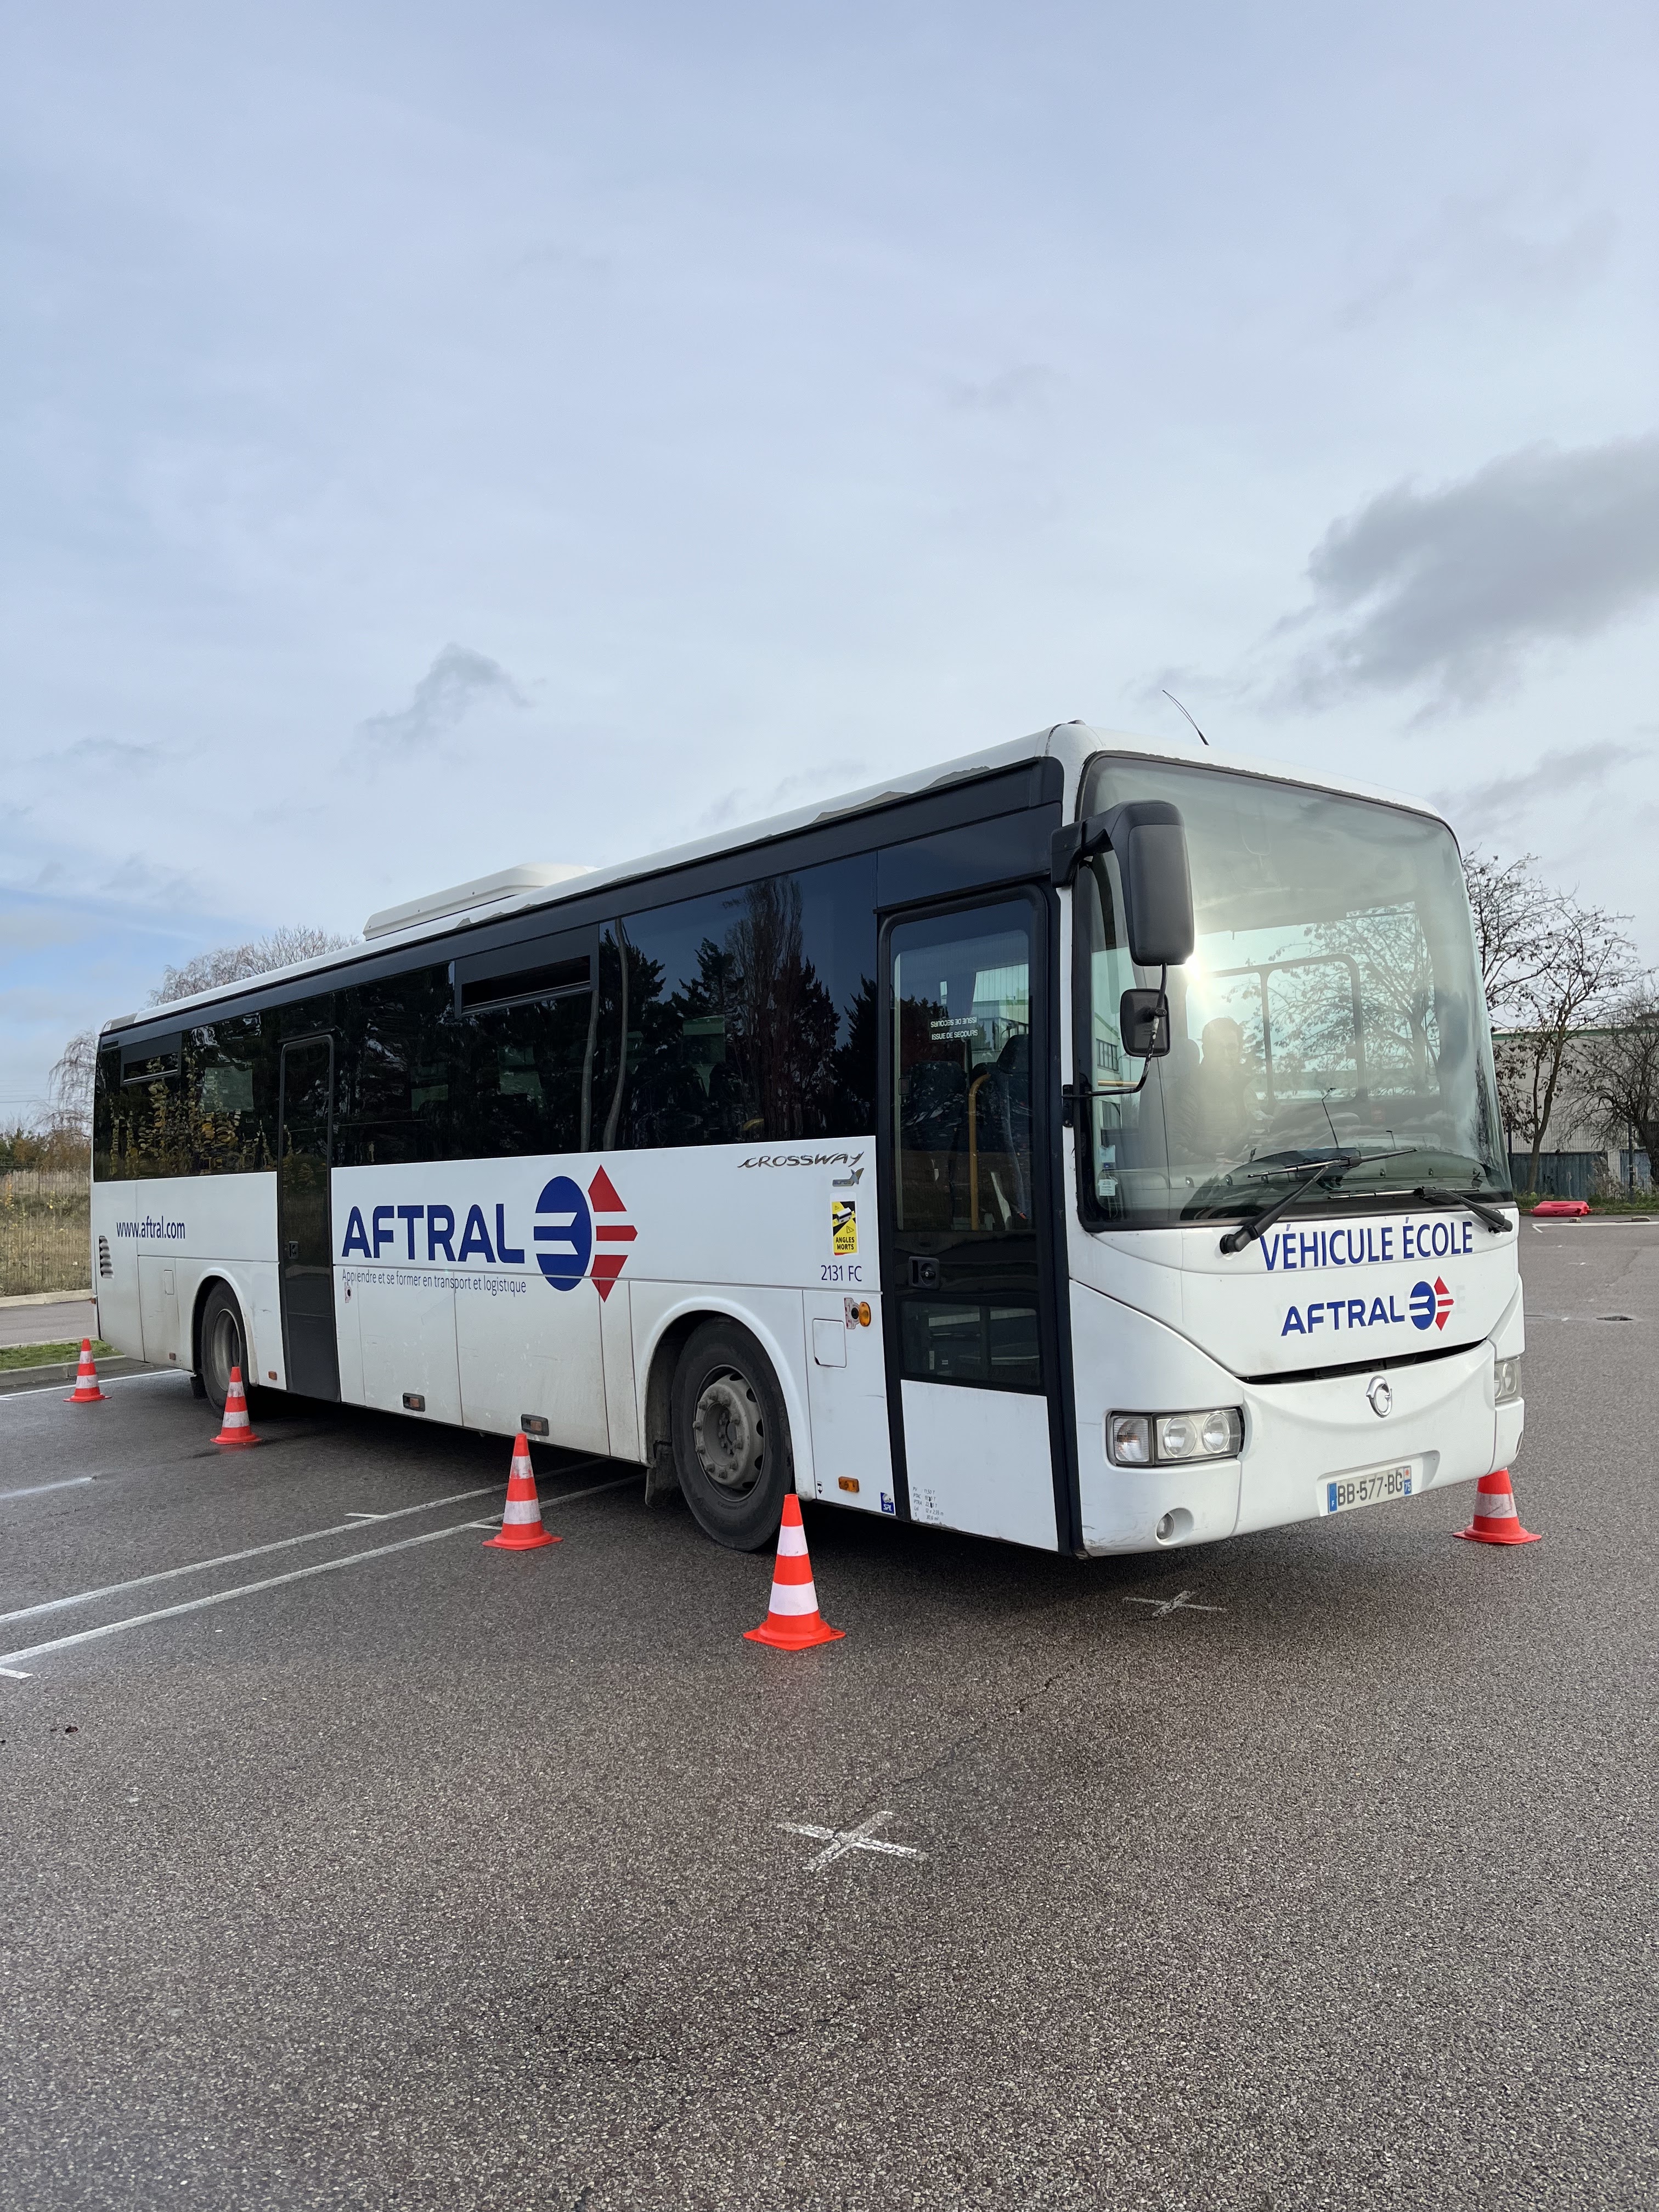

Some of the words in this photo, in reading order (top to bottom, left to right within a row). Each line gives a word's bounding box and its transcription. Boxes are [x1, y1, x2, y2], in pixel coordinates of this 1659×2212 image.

[930, 1019, 954, 1028] SECOURS
[737, 1152, 865, 1167] CROSSWAY
[116, 1215, 185, 1239] www.aftral.com
[341, 1203, 525, 1264] AFTRAL
[1260, 1223, 1393, 1271] VÉHICULE
[1402, 1216, 1473, 1259] ÉCOLE
[379, 1272, 385, 1284] et
[387, 1273, 394, 1284] se
[396, 1270, 421, 1286] former
[422, 1277, 432, 1287] en
[434, 1275, 471, 1294] transport
[473, 1277, 481, 1290] et
[483, 1274, 527, 1297] logistique
[821, 1265, 843, 1281] 2131
[849, 1266, 862, 1282] FC
[1280, 1295, 1405, 1336] AFTRAL
[1404, 1481, 1411, 1492] 75
